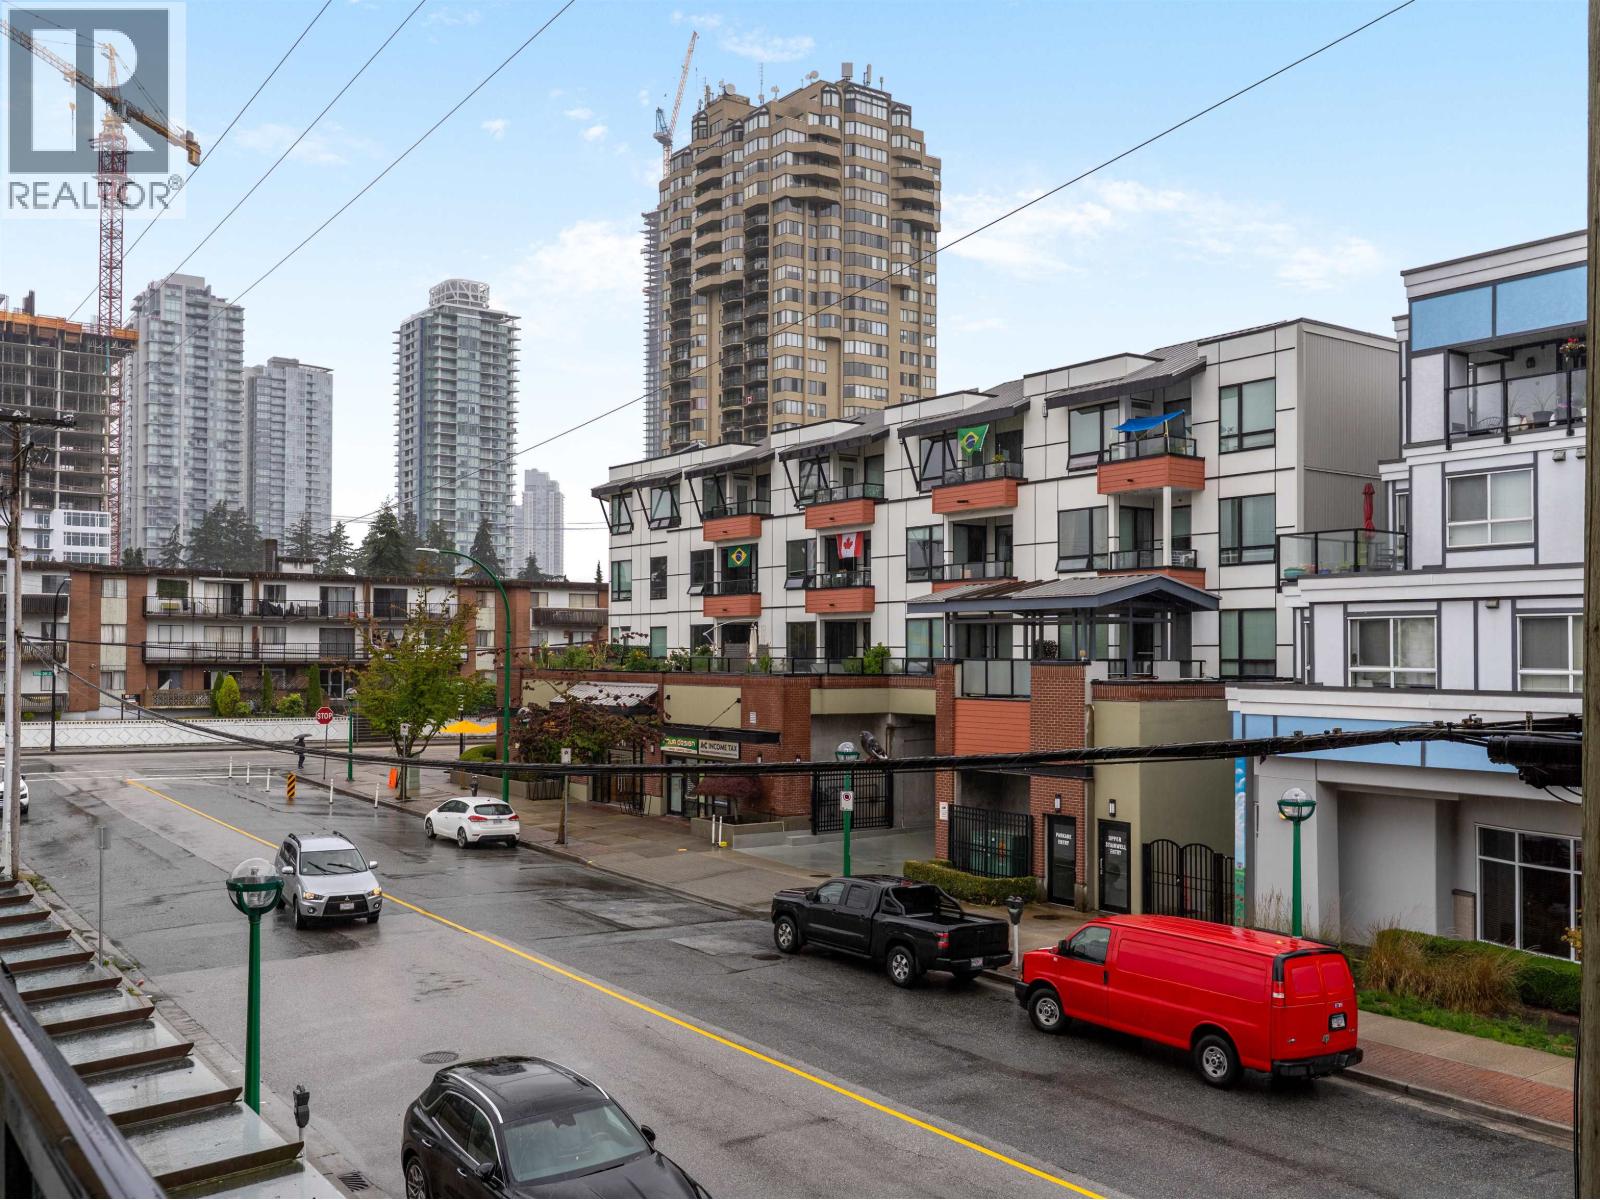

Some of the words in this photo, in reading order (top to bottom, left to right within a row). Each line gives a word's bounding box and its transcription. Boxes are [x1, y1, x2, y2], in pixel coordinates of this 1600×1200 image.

[708, 742, 727, 751] INCOME
[727, 744, 738, 752] TAX
[1106, 842, 1126, 850] STAIRWELL
